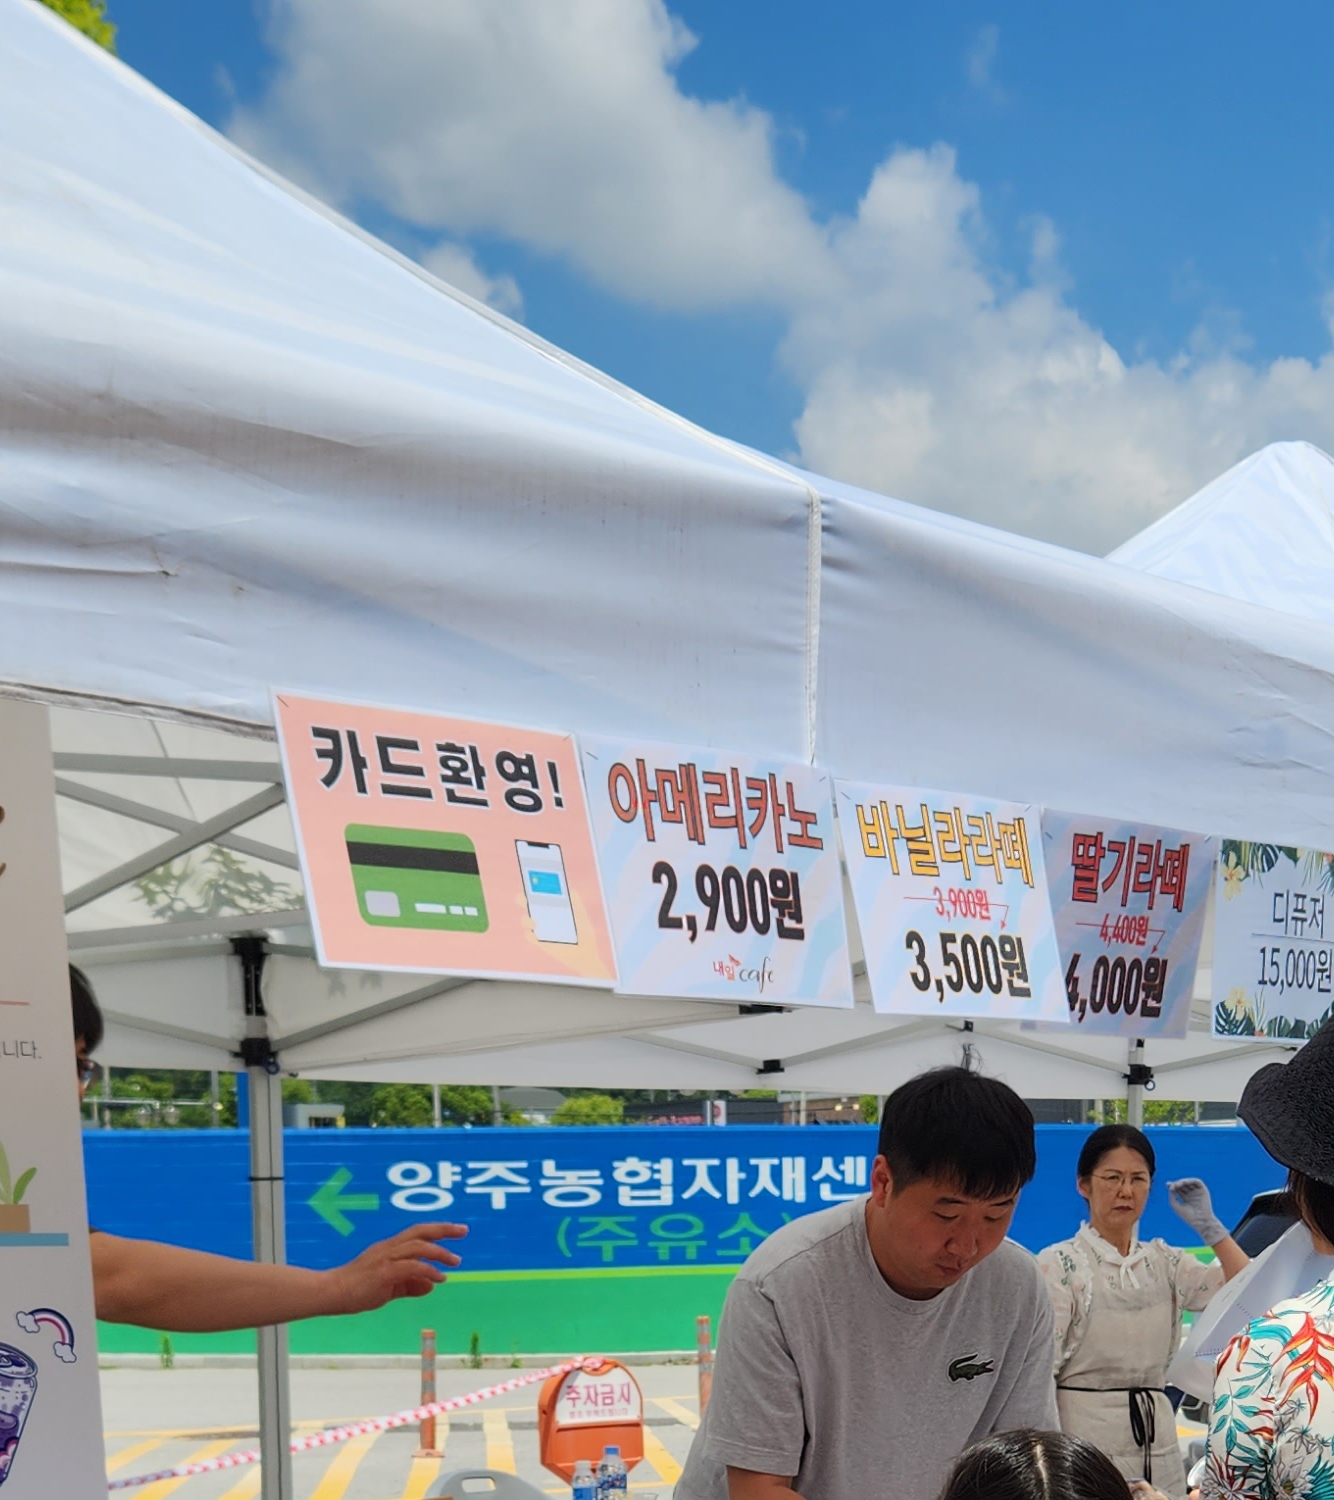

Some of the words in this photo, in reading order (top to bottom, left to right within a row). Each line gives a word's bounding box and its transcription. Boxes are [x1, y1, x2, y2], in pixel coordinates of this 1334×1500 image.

[309, 725, 565, 813] 카드환영!
[609, 758, 824, 852] 아메리카노
[856, 801, 1034, 888] 바닐라라떼
[1072, 832, 1190, 912] 딸기라떼
[651, 861, 805, 943] 2,900원
[933, 886, 991, 922] 3,900원
[1100, 913, 1149, 947] 4,400원
[1273, 890, 1325, 939] 디퓨저
[739, 957, 774, 993] cafe
[906, 930, 1031, 1002] 3,500원
[1065, 953, 1168, 1023] 4,000원
[1258, 947, 1333, 995] 15,000원
[387, 1156, 873, 1212] 양주농협자재센
[558, 1212, 791, 1262] (주유소
